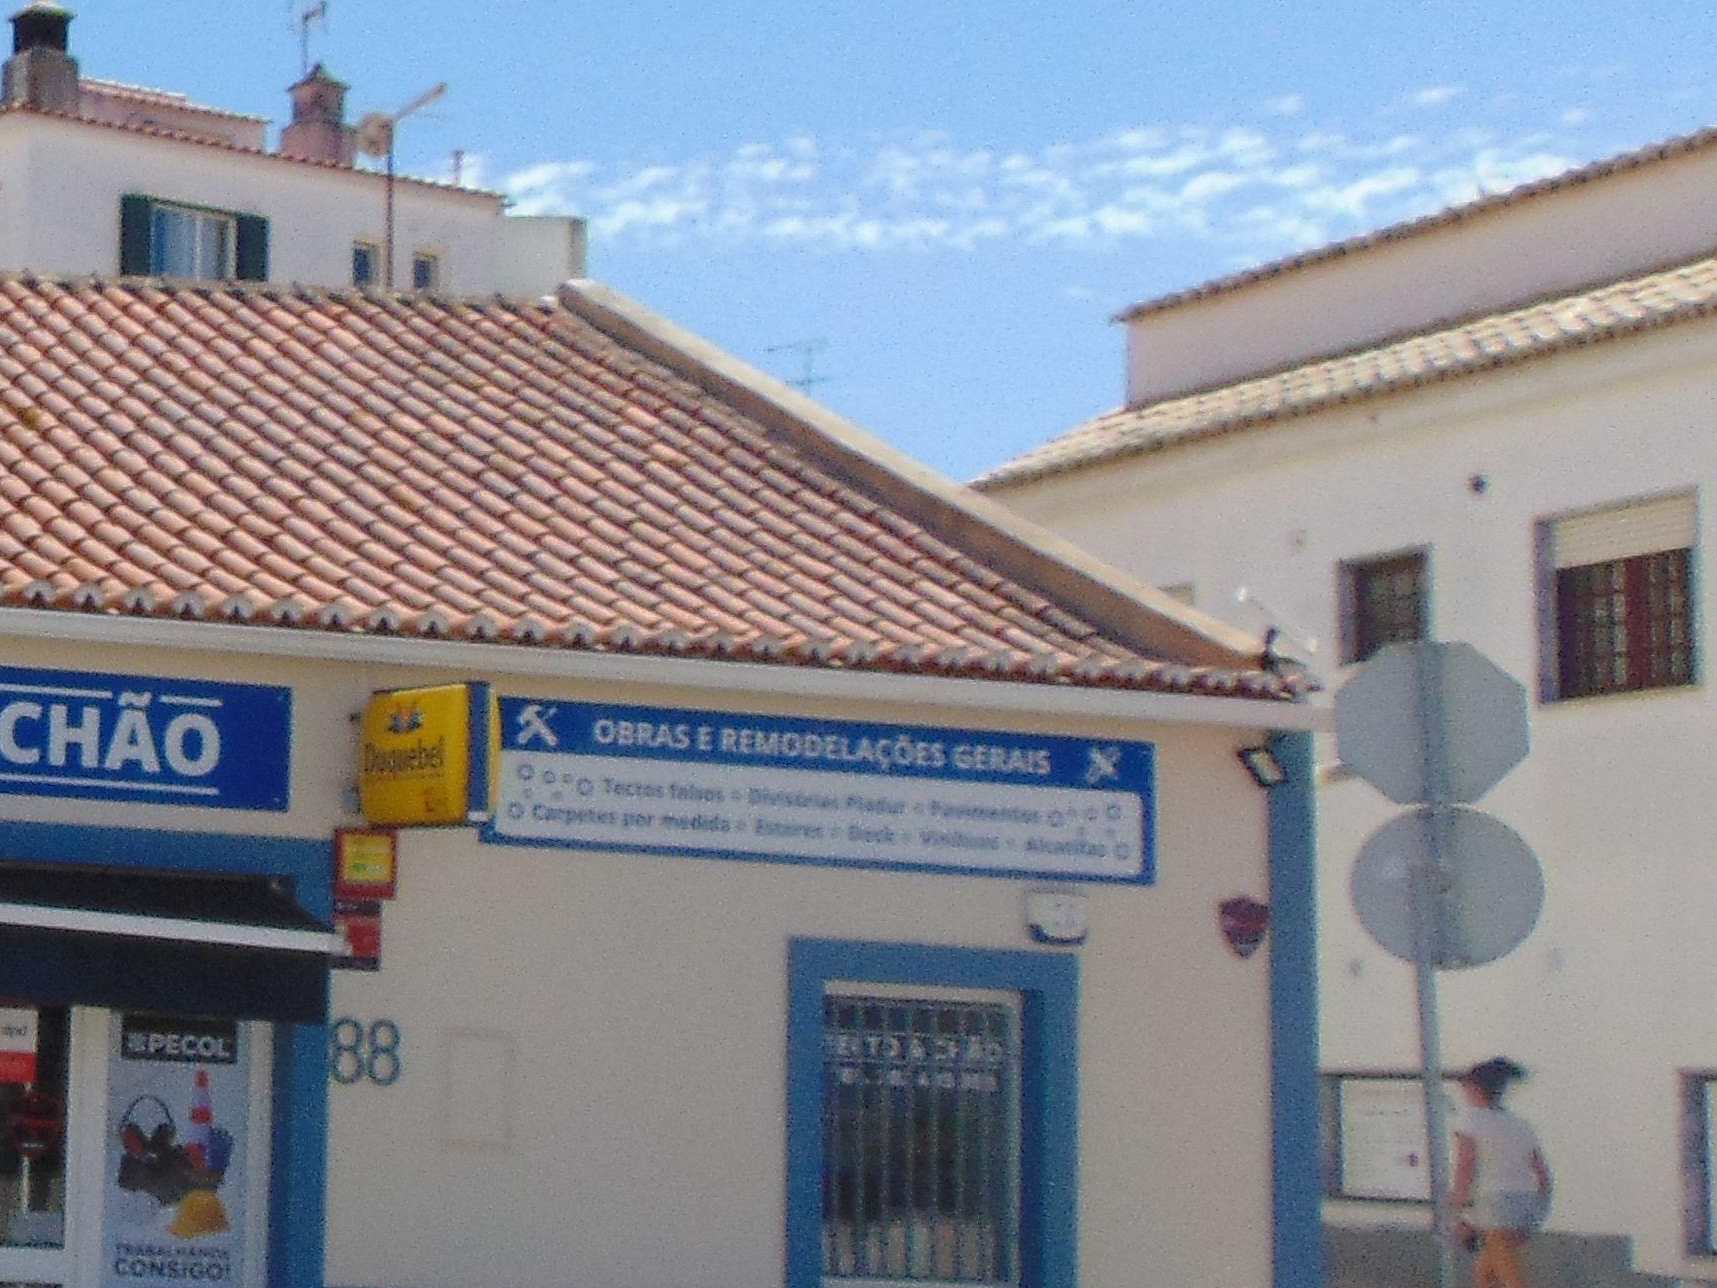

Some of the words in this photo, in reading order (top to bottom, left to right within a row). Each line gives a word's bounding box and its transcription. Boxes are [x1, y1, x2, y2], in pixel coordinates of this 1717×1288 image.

[592, 719, 691, 749] OBRAS
[697, 726, 714, 751] E
[721, 728, 946, 773] REMODELAÇÕES
[951, 742, 1052, 775] GERAIS
[148, 1034, 231, 1058] PECOL
[329, 1017, 403, 1086] 88
[113, 1257, 232, 1281] CONSIGO!
